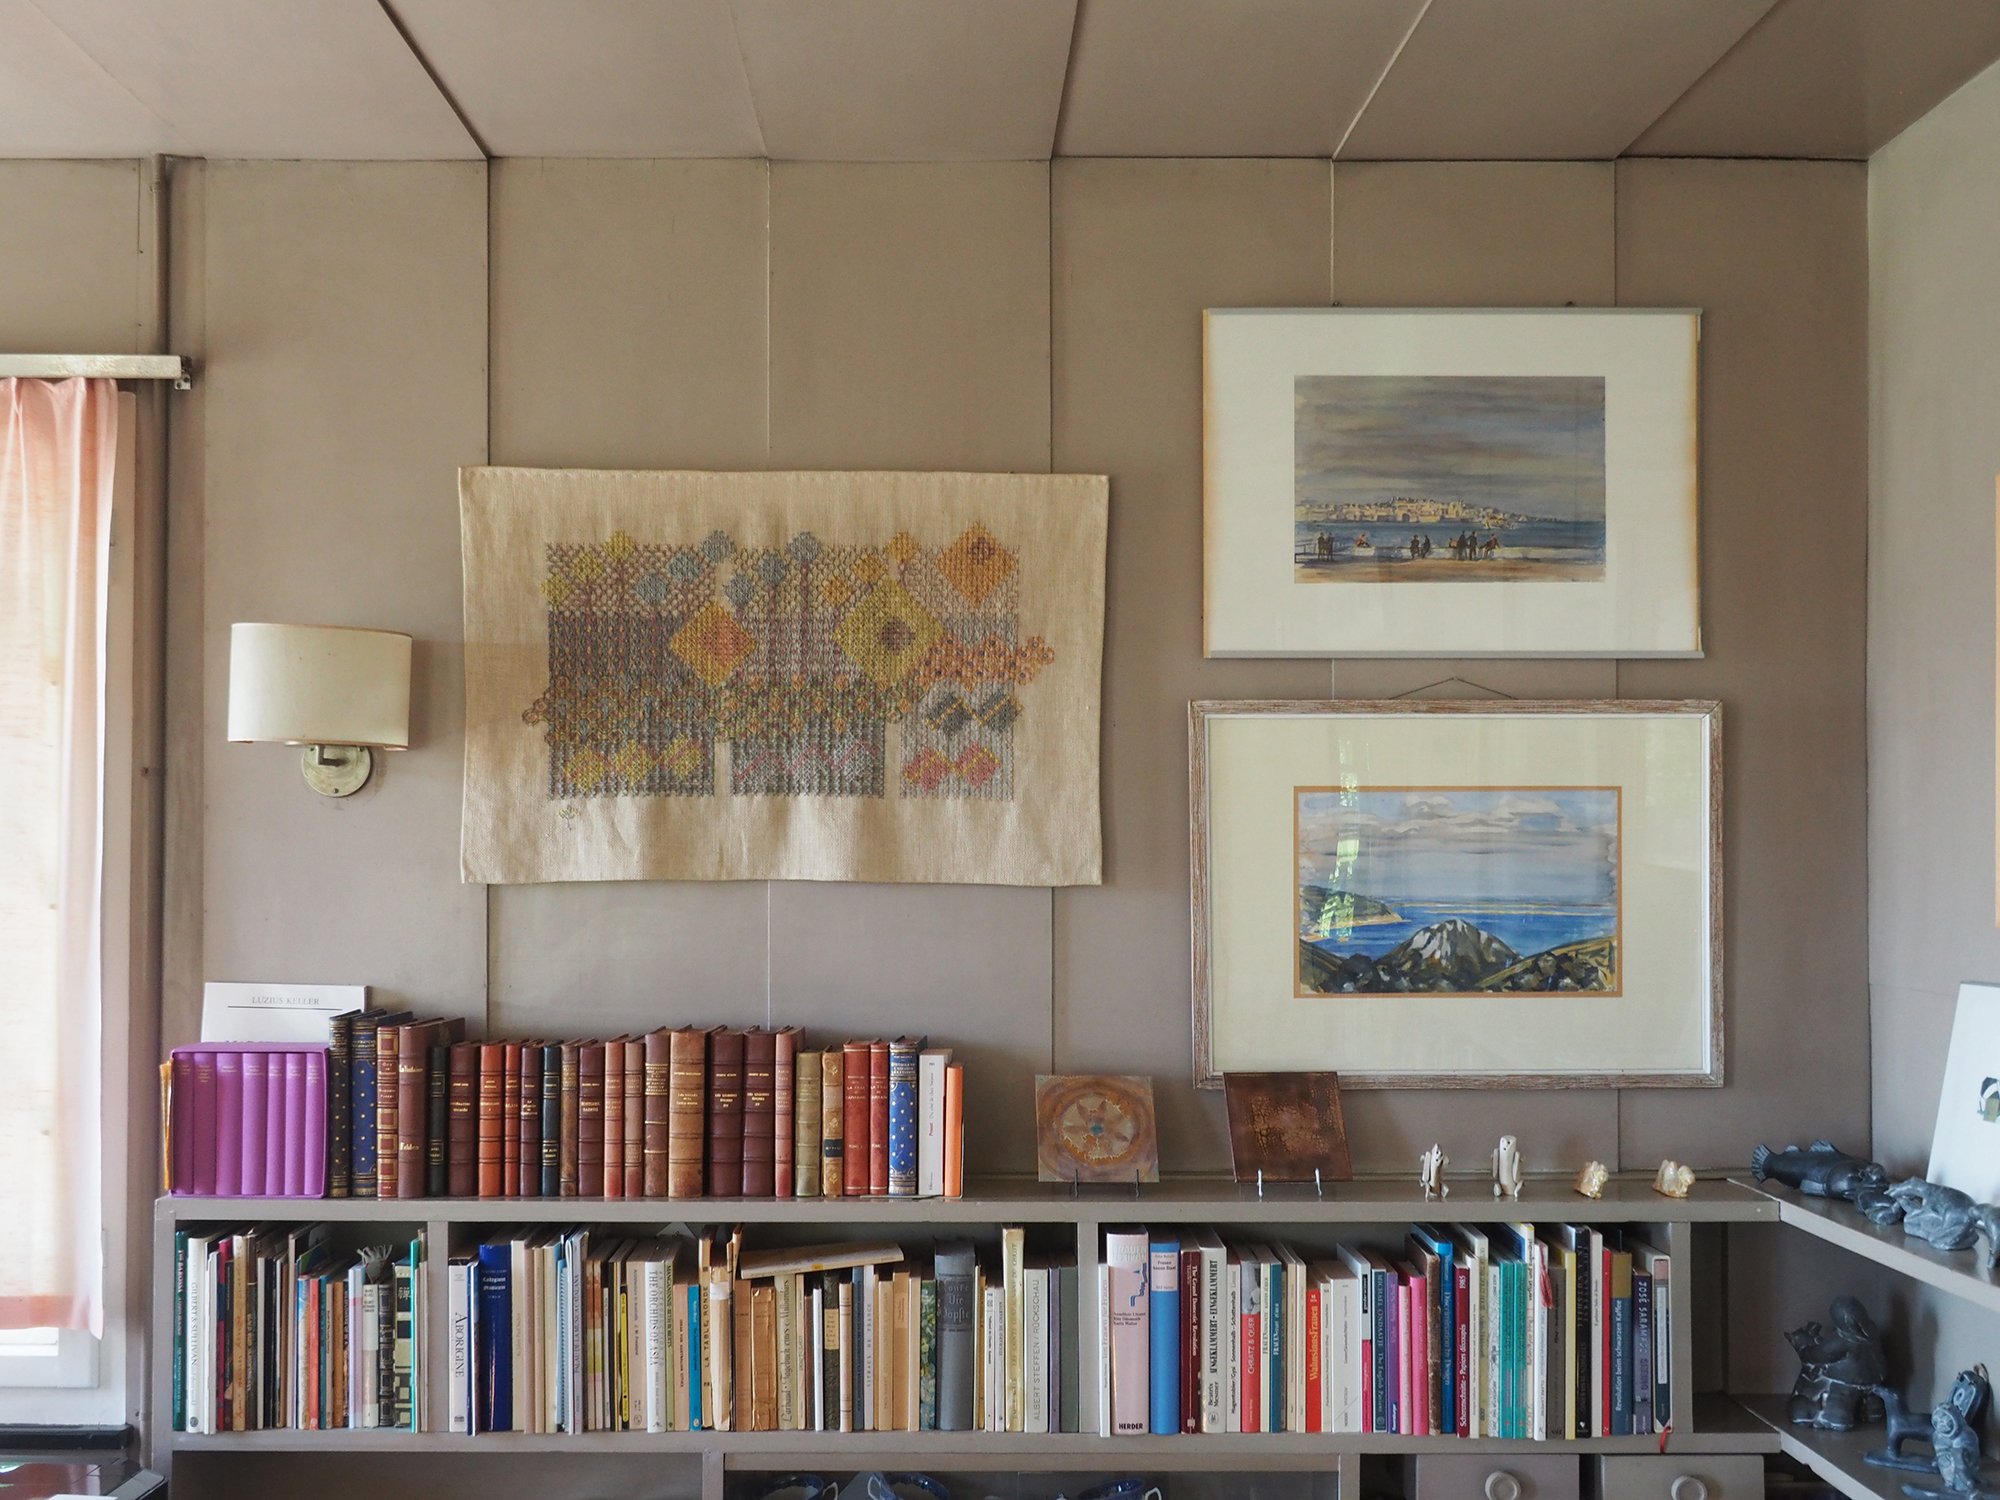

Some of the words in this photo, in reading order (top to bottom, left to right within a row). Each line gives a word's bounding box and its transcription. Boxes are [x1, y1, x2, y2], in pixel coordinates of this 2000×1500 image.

[252, 996, 284, 1004] LUZIUS
[286, 997, 320, 1005] KELLER
[1010, 1243, 1018, 1266] CHRIST
[1112, 1243, 1147, 1253] FRAUEN
[1112, 1253, 1147, 1263] LEXIKON
[1577, 1245, 1583, 1256] IN
[648, 1270, 659, 1289] THE
[658, 1270, 664, 1280] AN
[1011, 1268, 1017, 1278] DU
[1459, 1274, 1467, 1289] 1985
[1209, 1259, 1218, 1315] EINGEKLAMMERT
[1638, 1281, 1650, 1304] JOSÉ
[190, 1281, 198, 1315] GILBERT
[1032, 1279, 1040, 1334] RÜCKSCHAU
[648, 1290, 659, 1330] ORCHIDS
[573, 1333, 580, 1341] LA
[783, 1328, 791, 1346] eines
[1247, 1317, 1255, 1337] QUER
[1638, 1306, 1648, 1354] SARAMAGO
[190, 1324, 198, 1366] SULLIVAN
[573, 1341, 580, 1351] DE
[648, 1332, 659, 1344] OF
[866, 1339, 872, 1348] DE
[1209, 1319, 1218, 1374] AUSGEKLAMMERT
[1309, 1305, 1319, 1381] WahnsinnsFrauen
[1459, 1323, 1467, 1353] découpés
[648, 1345, 659, 1366] ASIA
[658, 1357, 664, 1367] TO
[704, 1356, 710, 1367] LA
[1033, 1342, 1041, 1384] STEFFEN
[1247, 1345, 1255, 1374] CHRATZ
[1443, 1349, 1450, 1357] by
[780, 1348, 792, 1384] Tagebuch
[1459, 1353, 1467, 1375] Papiers
[1639, 1358, 1649, 1391] SEEING
[780, 1390, 792, 1423] Larbaud
[1033, 1386, 1041, 1421] ALBERT
